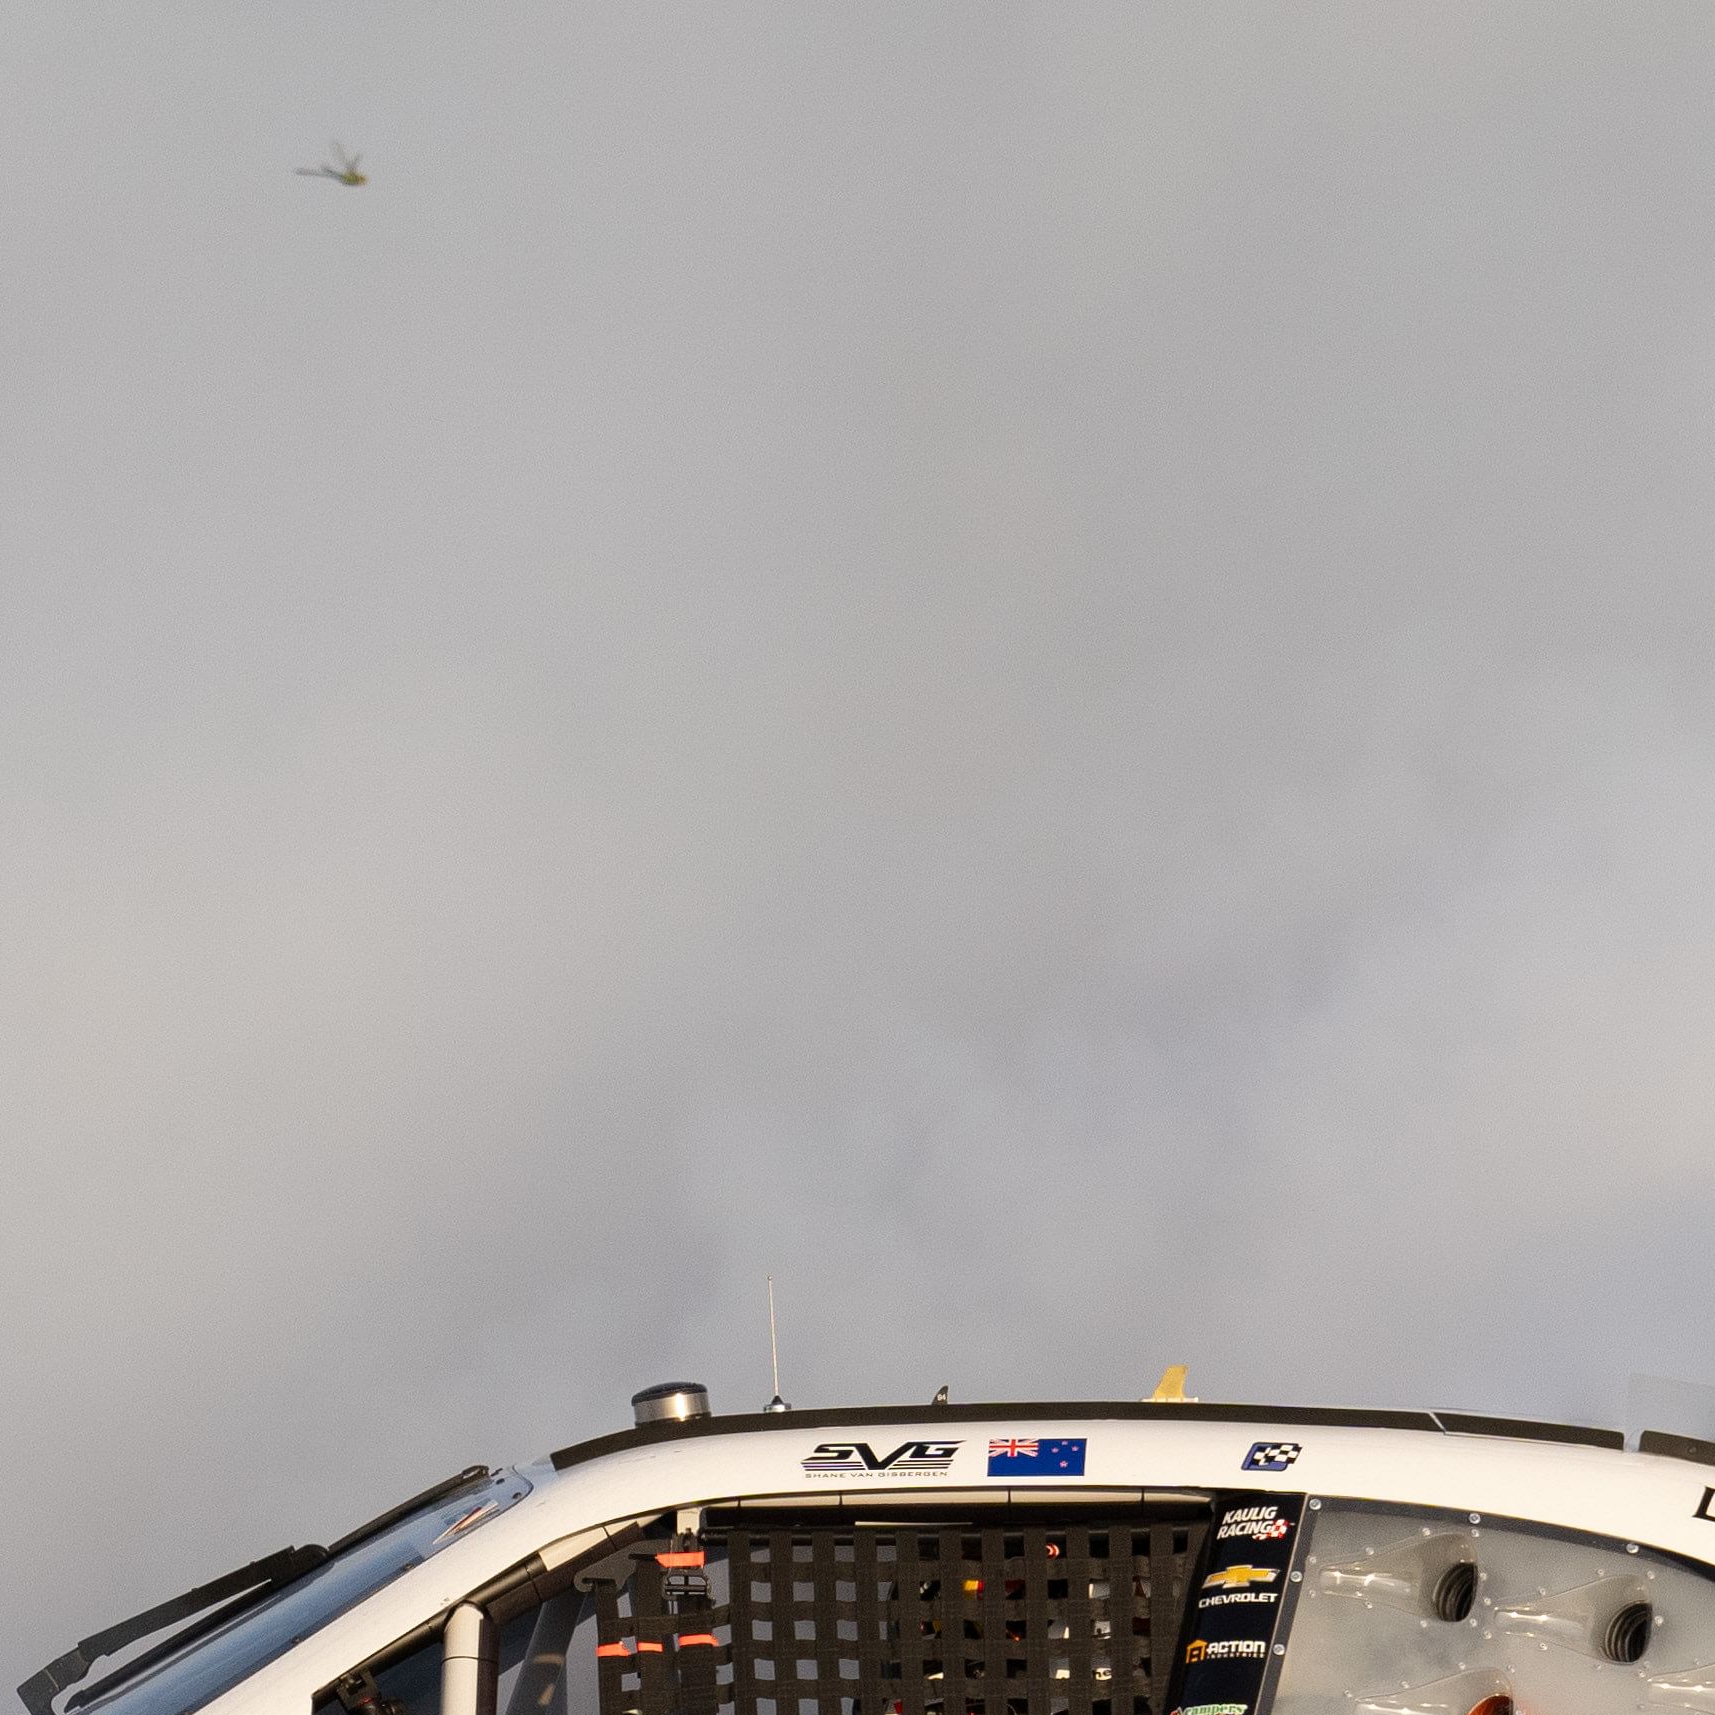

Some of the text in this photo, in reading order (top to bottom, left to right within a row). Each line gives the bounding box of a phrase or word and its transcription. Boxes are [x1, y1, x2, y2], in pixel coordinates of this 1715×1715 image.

[801, 1440, 966, 1470] SVG
[1222, 1506, 1278, 1524] KAULIG
[1216, 1521, 1271, 1540] RACING
[1199, 1592, 1278, 1609] CHEVROLET
[1206, 1640, 1266, 1654] ACTION
